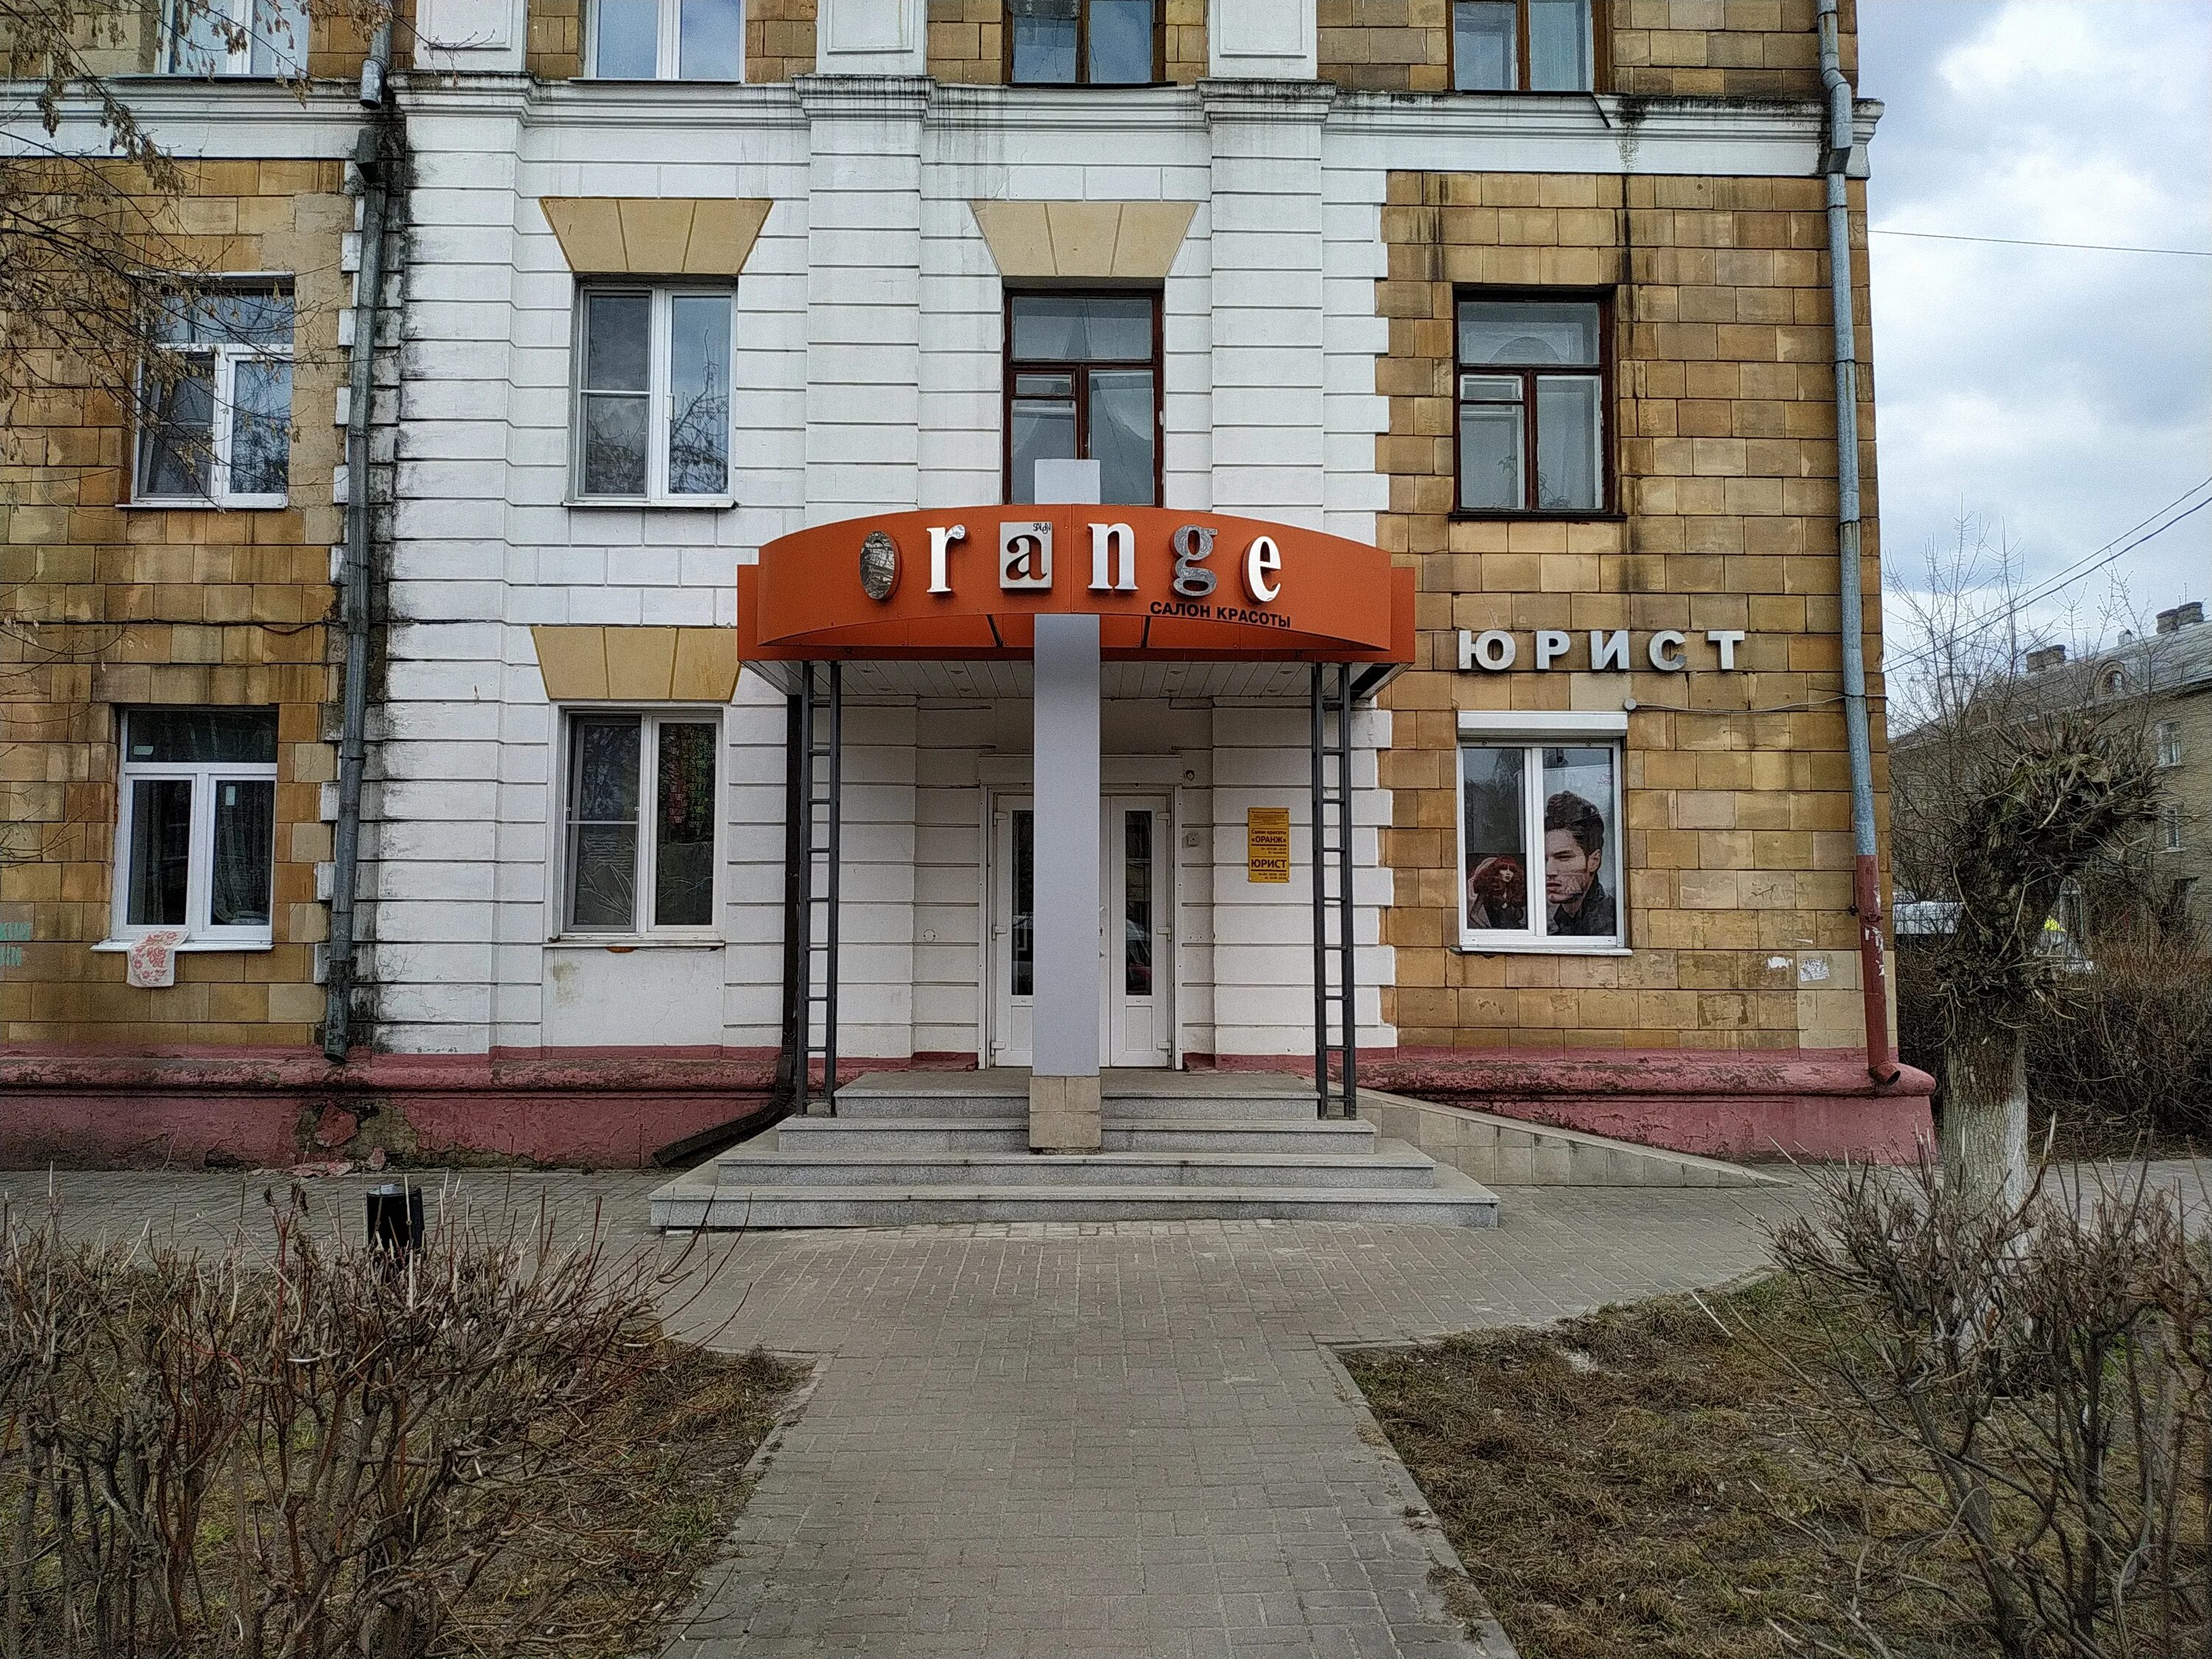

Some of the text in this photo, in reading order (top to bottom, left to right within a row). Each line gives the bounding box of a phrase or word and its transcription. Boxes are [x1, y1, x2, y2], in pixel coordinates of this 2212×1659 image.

[860, 523, 1283, 602] orange
[1150, 601, 1291, 628] САЛОН КРАСОТЫ
[1458, 630, 1745, 671] ЮРИСТ
[1251, 859, 1287, 868] ЮРИСТ
